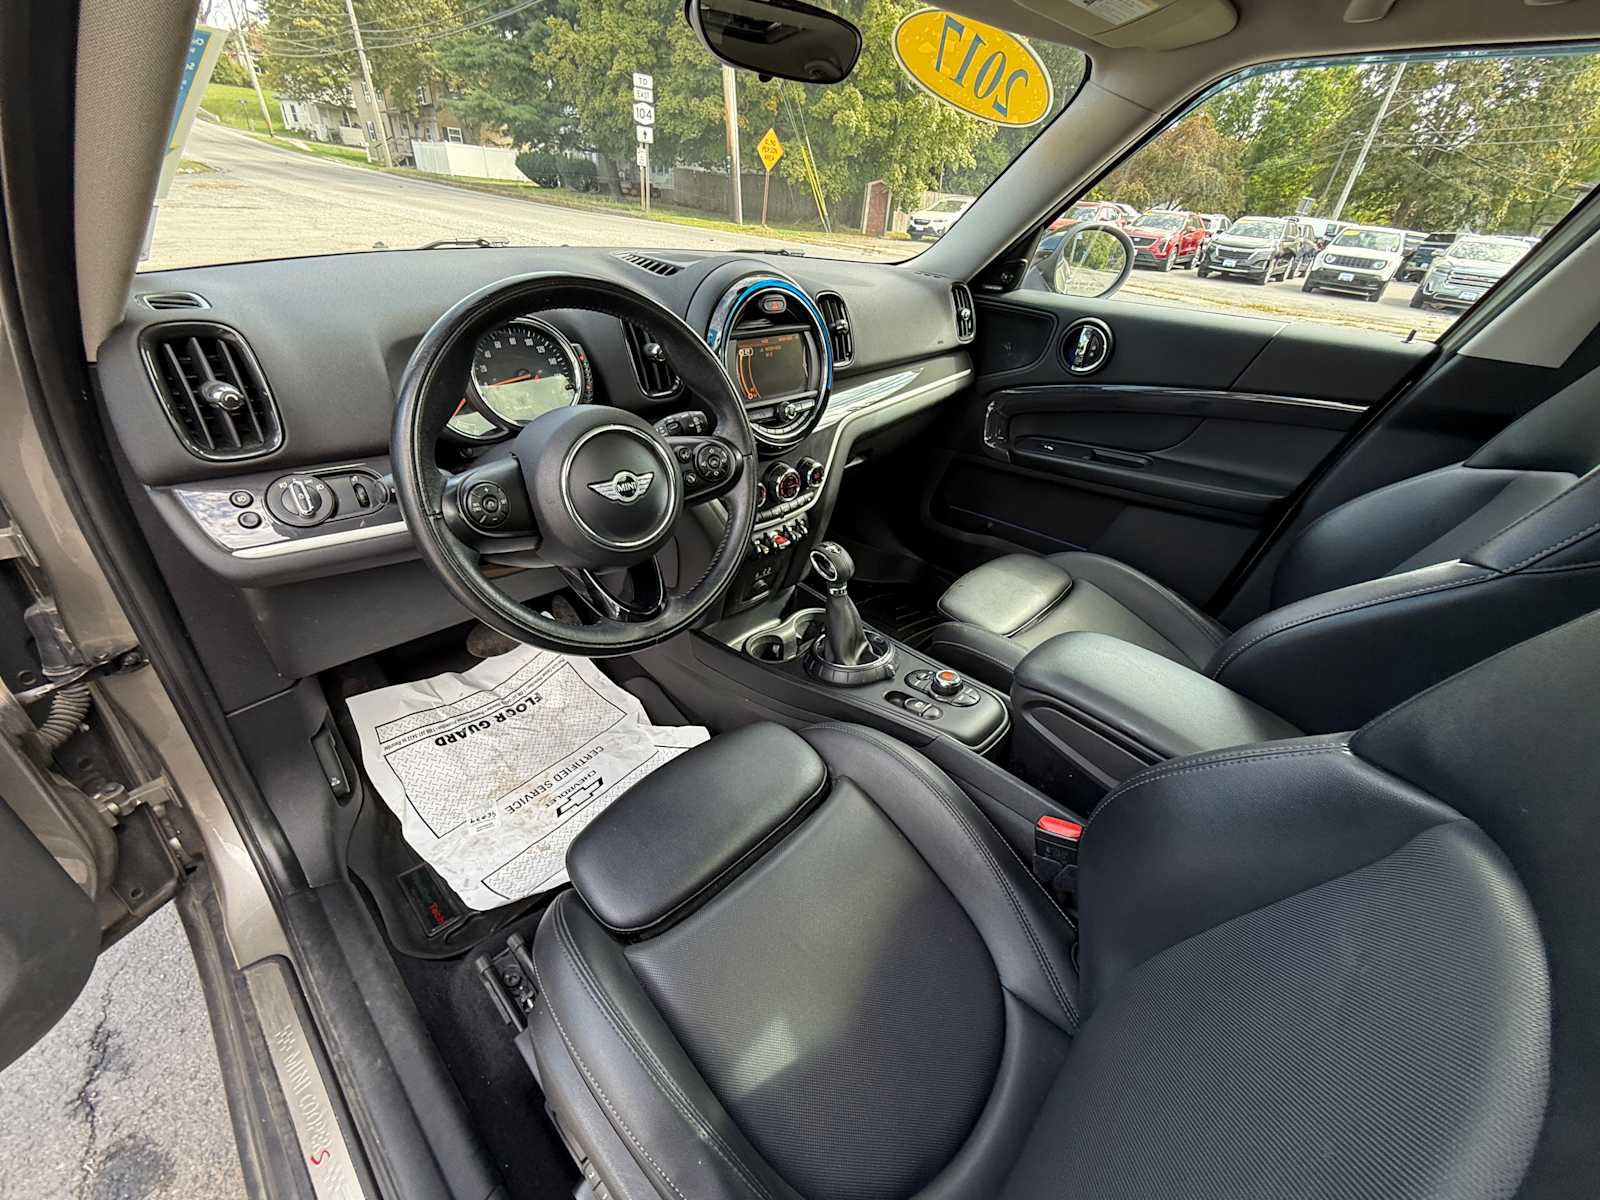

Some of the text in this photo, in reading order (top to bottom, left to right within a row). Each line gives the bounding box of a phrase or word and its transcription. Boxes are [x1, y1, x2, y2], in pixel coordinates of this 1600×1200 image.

[638, 77, 648, 85] TO
[636, 107, 652, 120] 104
[616, 481, 638, 492] MINI
[493, 691, 543, 723] FLOOR
[434, 720, 491, 747] GUARD
[504, 745, 604, 815] CERTIFIED SERVICE
[544, 769, 597, 808] CHEVROLET
[284, 1050, 313, 1096] MINI
[310, 1150, 332, 1166] S
